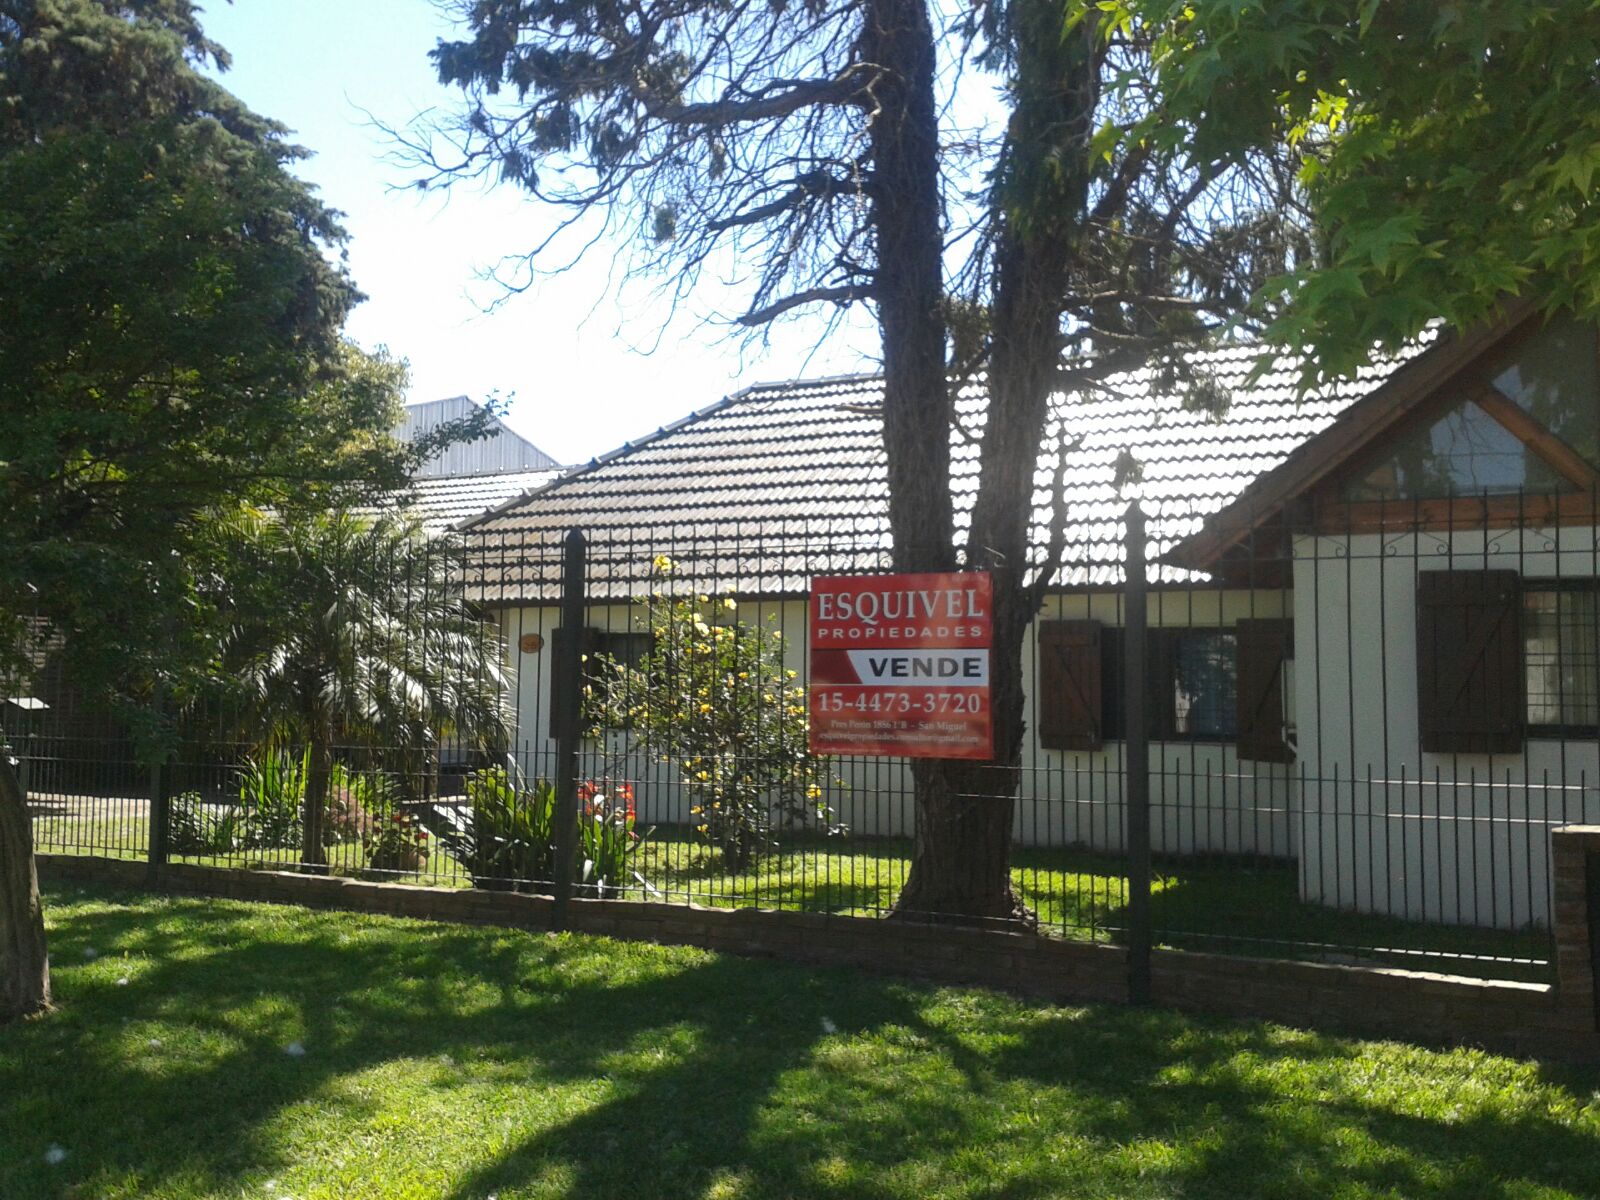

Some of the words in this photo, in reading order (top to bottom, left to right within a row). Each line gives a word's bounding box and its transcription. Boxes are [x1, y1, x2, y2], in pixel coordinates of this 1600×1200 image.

[818, 589, 984, 625] ESQUIVEL
[818, 626, 982, 639] PROPIEDADES
[868, 657, 982, 678] VENDE
[818, 693, 981, 713] 15-4473-3720
[918, 721, 934, 730] San
[936, 720, 967, 732] Miguel
